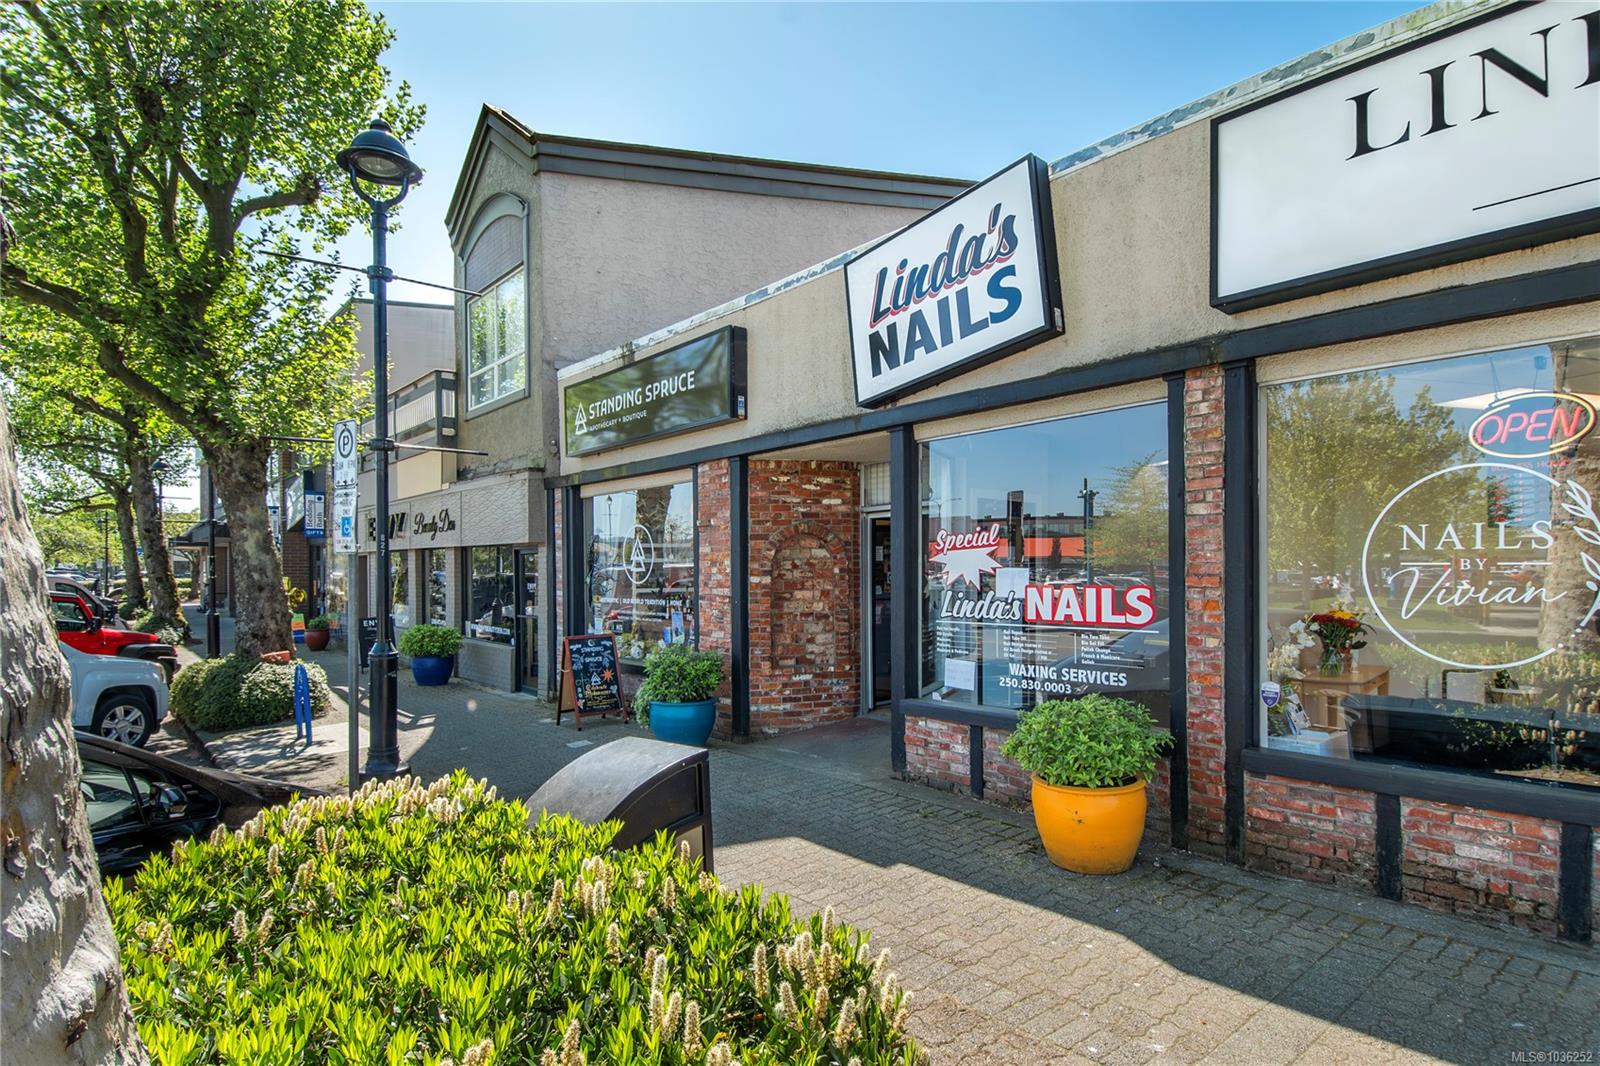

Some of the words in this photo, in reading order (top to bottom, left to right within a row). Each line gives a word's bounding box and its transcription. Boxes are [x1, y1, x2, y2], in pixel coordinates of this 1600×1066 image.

[869, 203, 1019, 328] Linda's
[868, 265, 1022, 378] NAILS
[588, 387, 642, 419] STANDING
[645, 370, 696, 402] SPRUCE
[622, 409, 647, 423] BOUTIQUE
[1476, 405, 1583, 445] OPEN
[439, 507, 456, 532] Den
[1400, 519, 1554, 551] NAILS
[934, 523, 1000, 556] Special
[1459, 557, 1488, 570] BY
[941, 590, 1022, 621] Linda's
[1025, 585, 1157, 626] NAILS
[1388, 567, 1568, 620] Vivian
[999, 677, 1072, 694] 250.830.0003
[1009, 663, 1057, 680] WAXING
[1061, 668, 1128, 687] SERVICES
